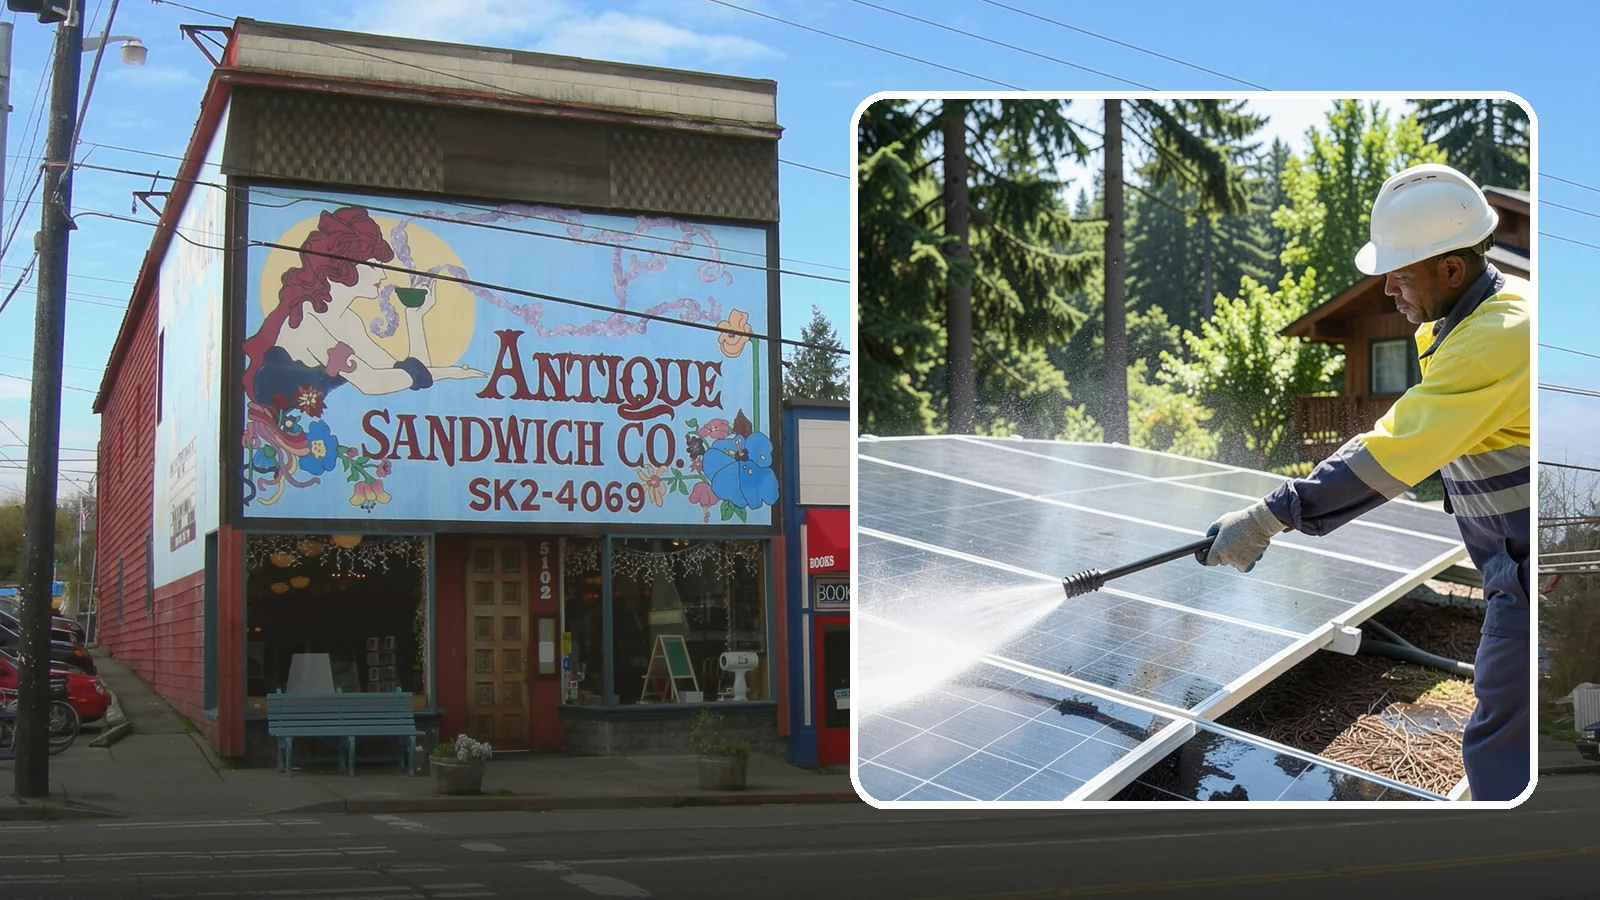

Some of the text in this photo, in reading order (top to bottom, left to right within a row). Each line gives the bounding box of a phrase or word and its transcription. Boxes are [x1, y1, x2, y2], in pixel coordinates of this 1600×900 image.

[476, 329, 723, 421] ANTIQUE
[361, 408, 684, 469] SANDWICH CO.
[468, 477, 645, 513] SK2-4069
[540, 541, 551, 600] 5102
[809, 555, 835, 569] BOOKS
